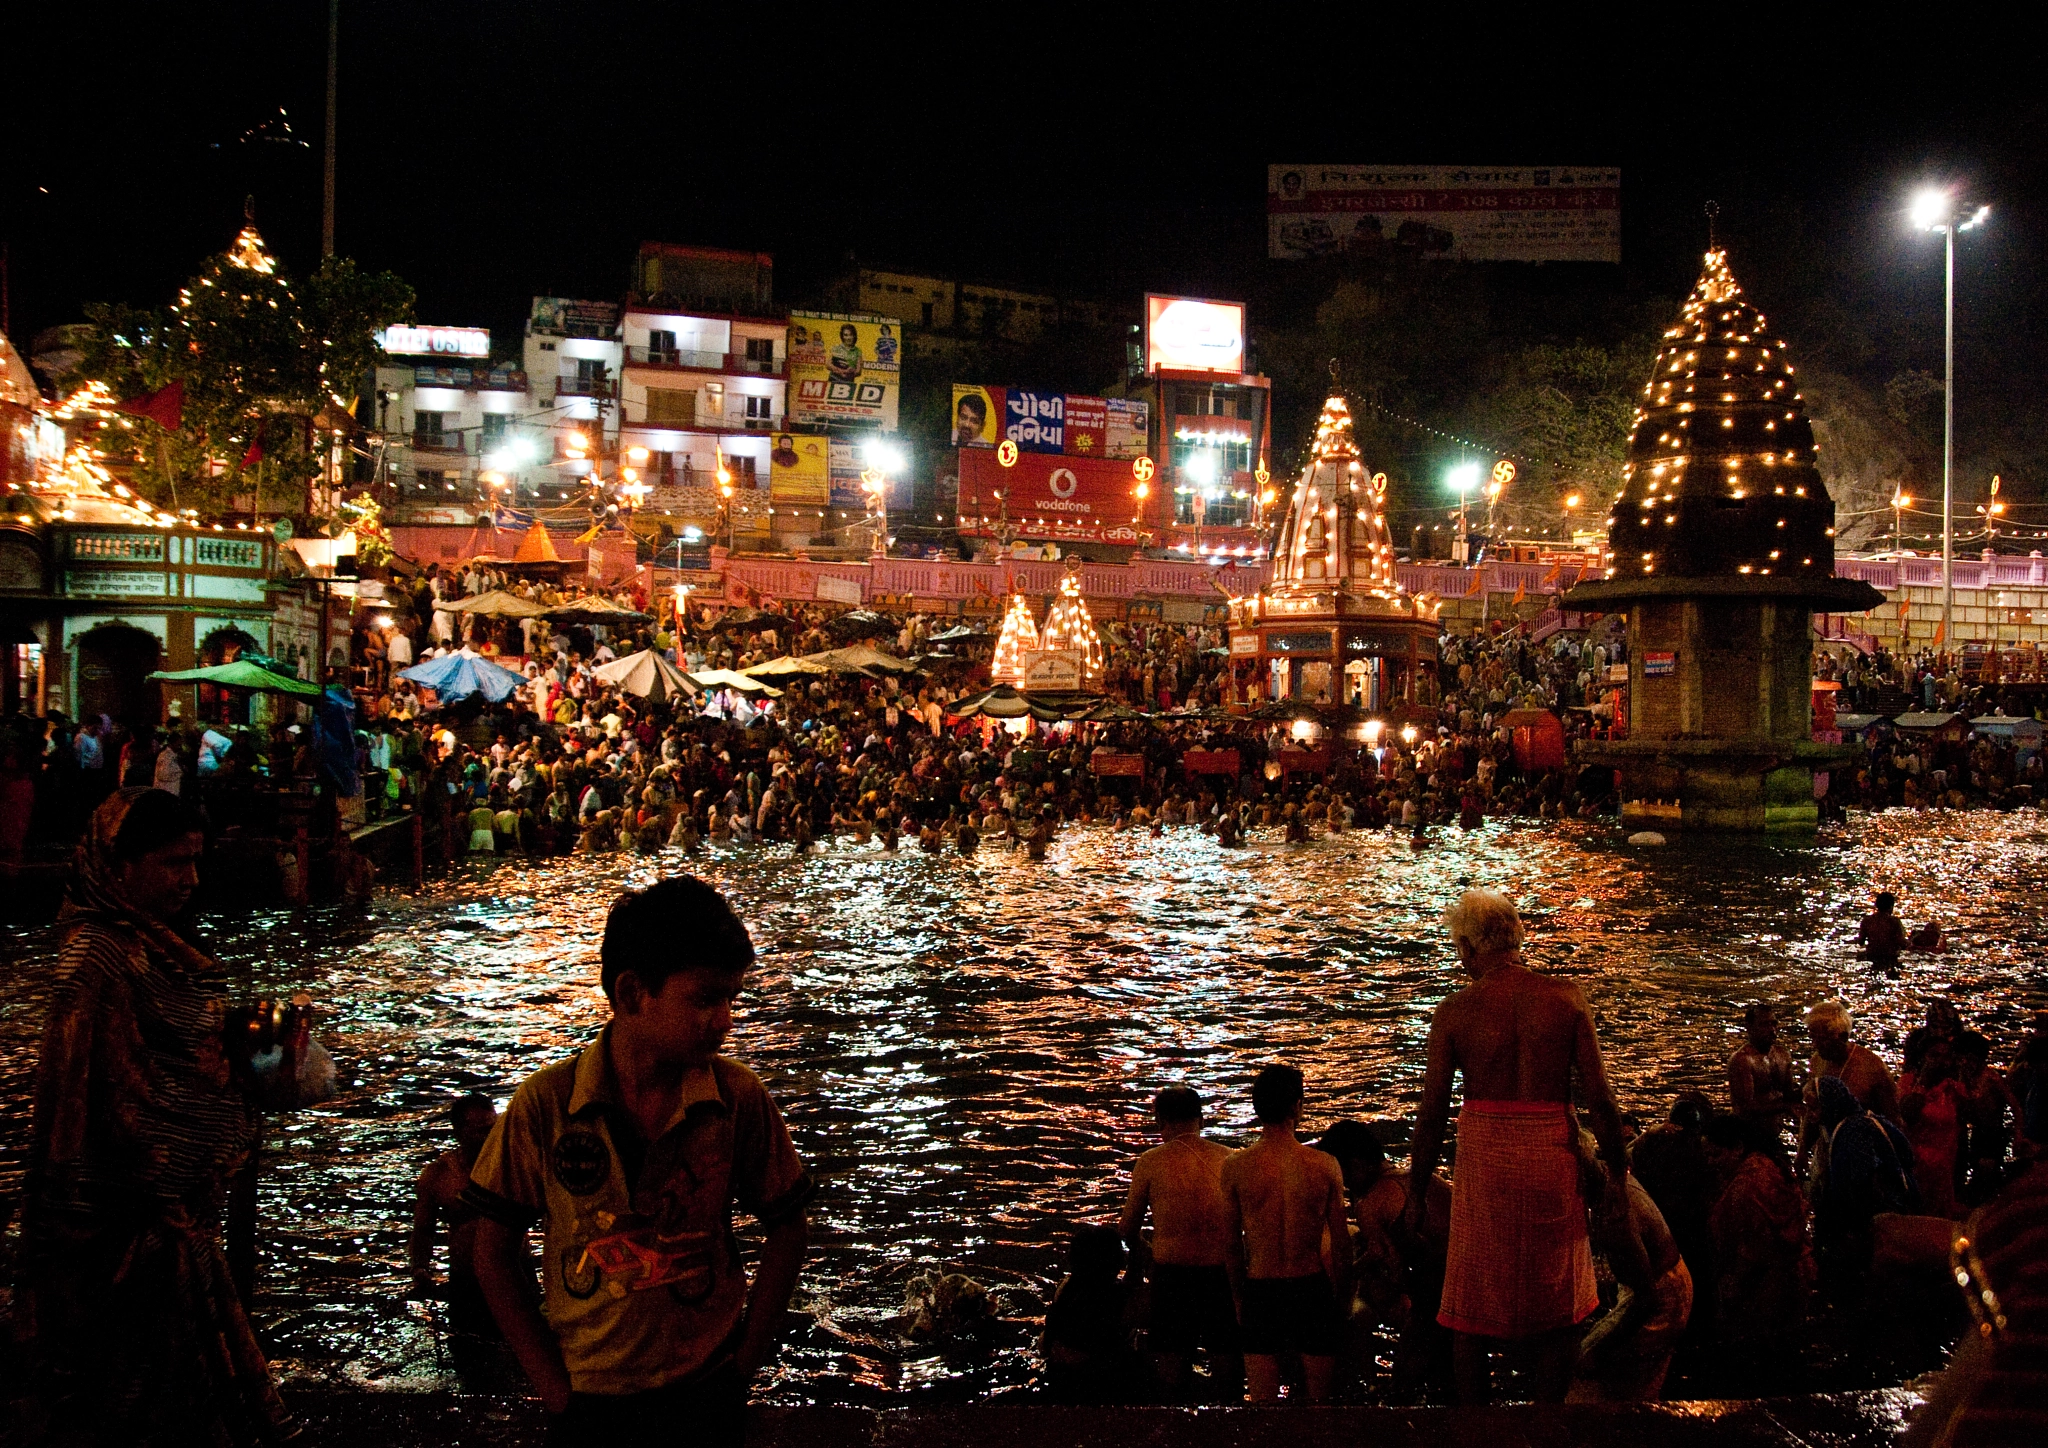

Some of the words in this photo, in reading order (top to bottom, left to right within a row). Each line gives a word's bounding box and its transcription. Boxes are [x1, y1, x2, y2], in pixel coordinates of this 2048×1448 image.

[863, 361, 899, 371] MODERN
[801, 381, 881, 401] MBD
[806, 404, 874, 415] BOOKS
[1008, 392, 1064, 420] चौथी
[1035, 499, 1091, 513] vodafone
